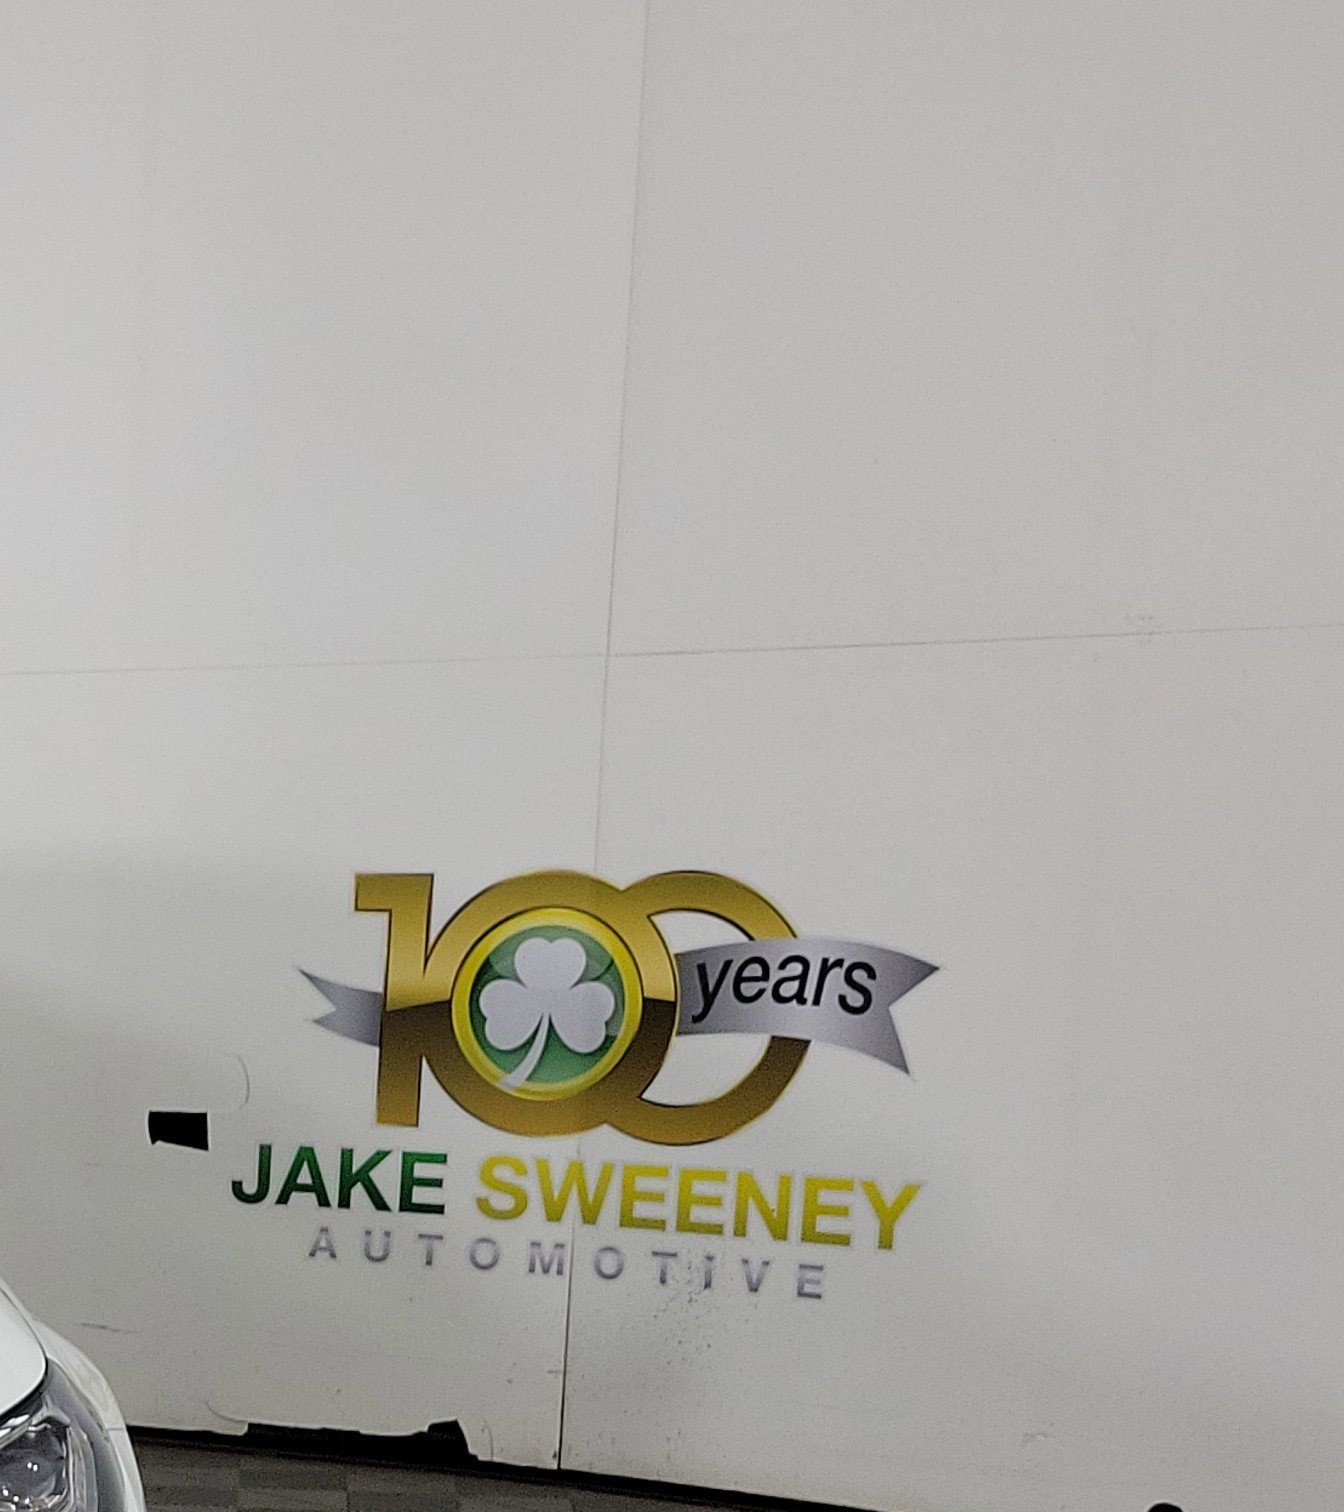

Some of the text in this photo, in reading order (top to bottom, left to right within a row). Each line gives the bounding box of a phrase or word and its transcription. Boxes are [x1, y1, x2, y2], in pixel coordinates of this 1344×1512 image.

[353, 869, 811, 1147] 100
[691, 954, 878, 1023] years
[231, 1143, 923, 1252] JAKE SWEENEY
[308, 1226, 827, 1300] AUTOMOTIVE
